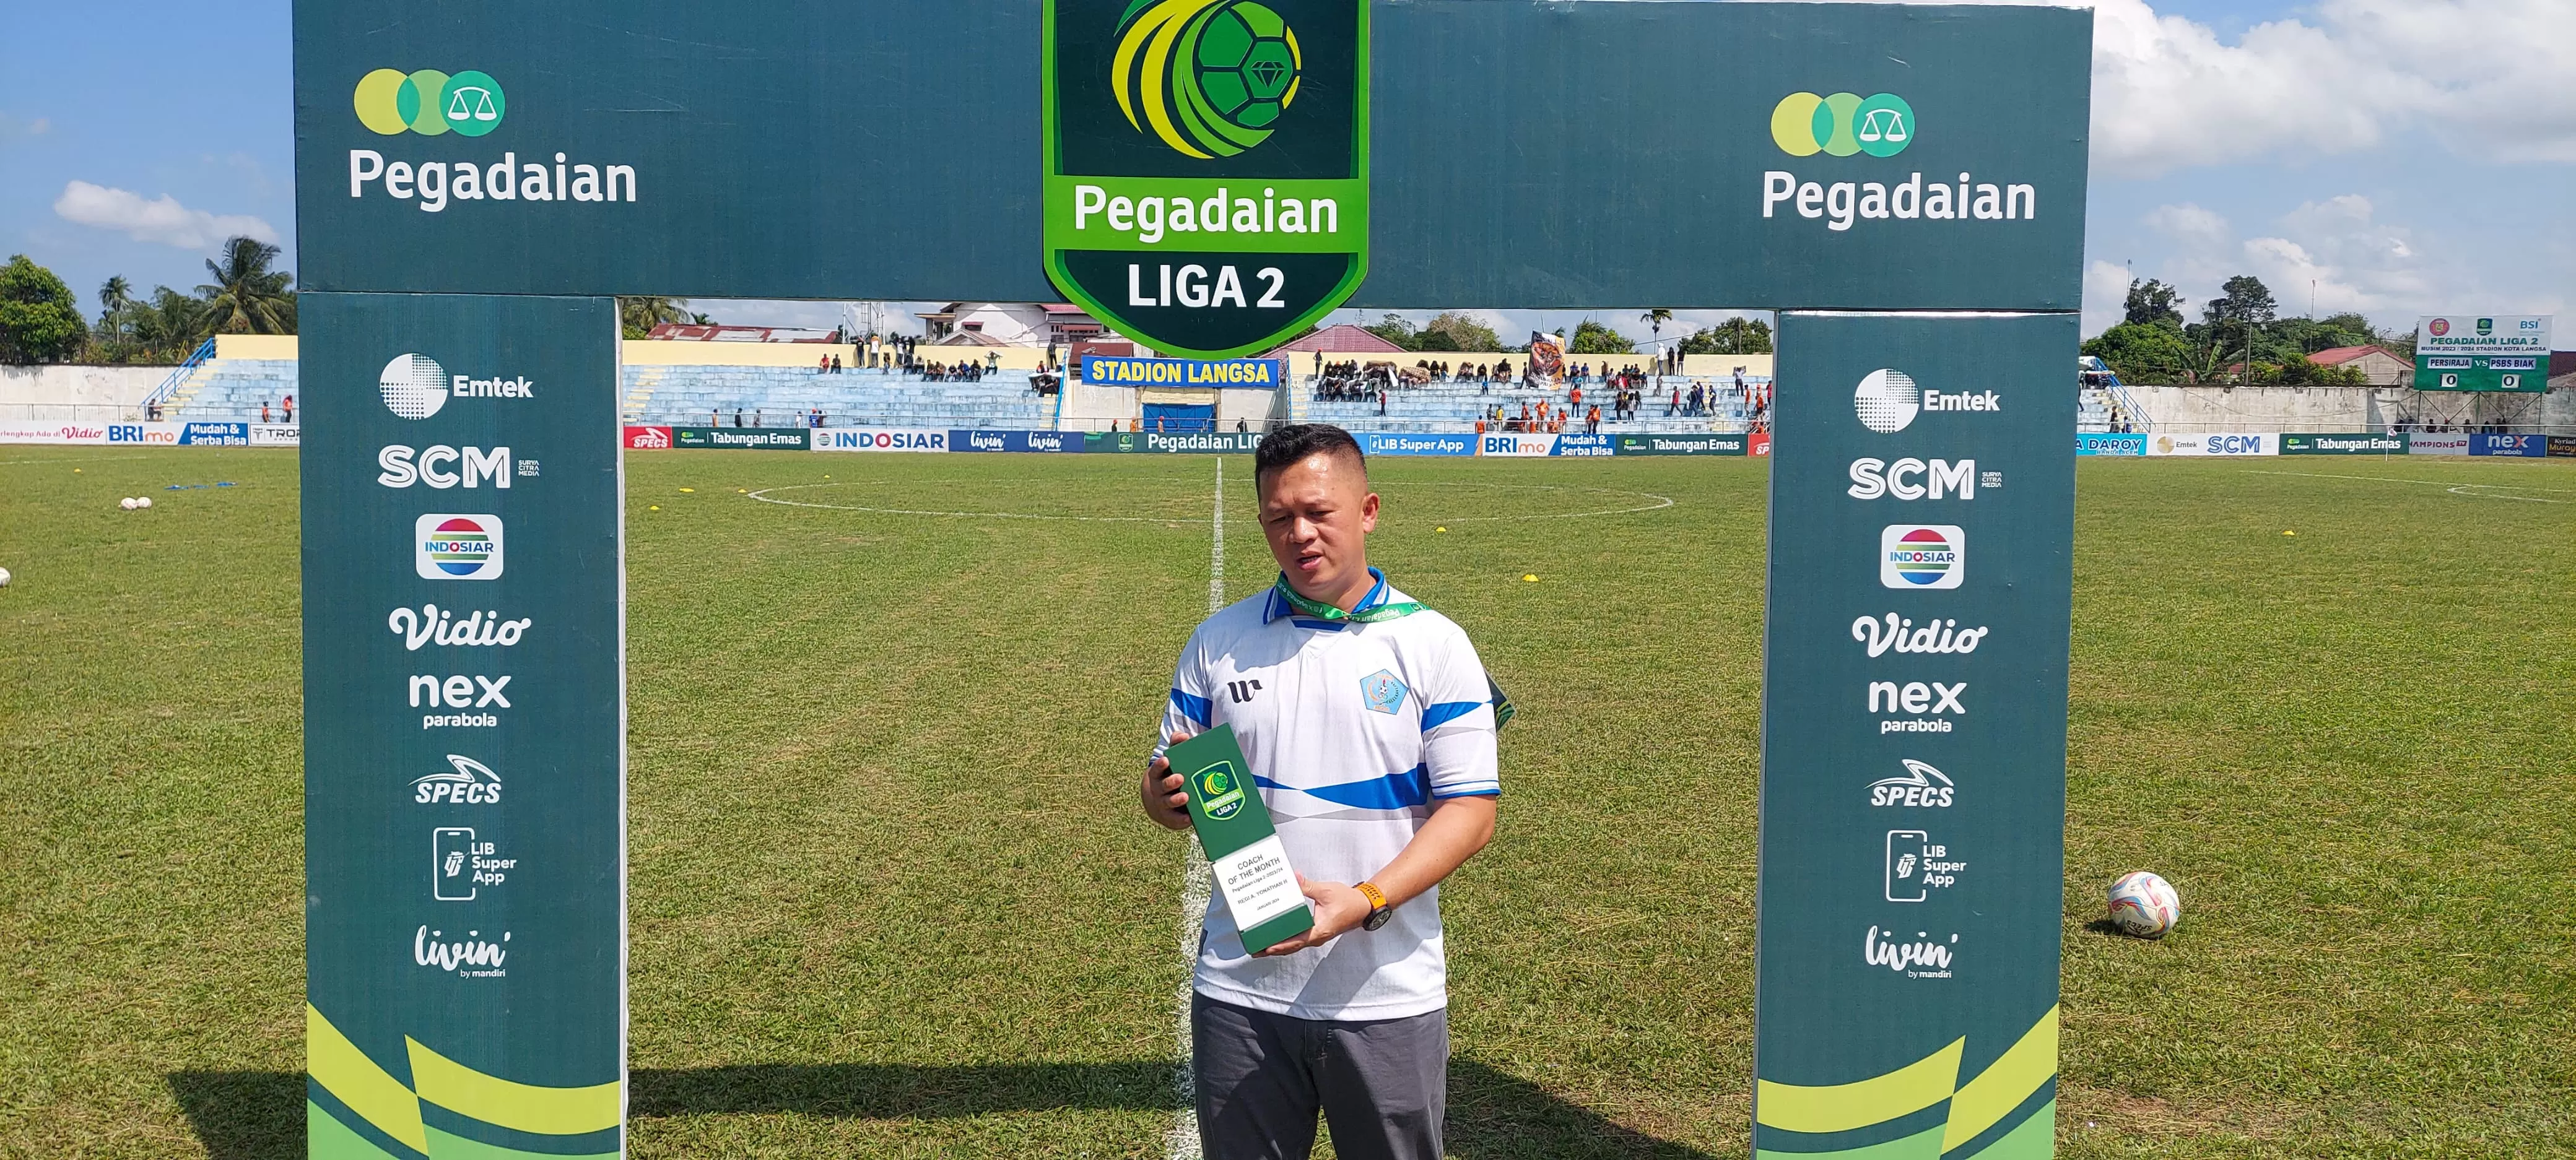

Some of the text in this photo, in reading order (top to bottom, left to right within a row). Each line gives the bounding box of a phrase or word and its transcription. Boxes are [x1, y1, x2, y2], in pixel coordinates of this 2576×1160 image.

[350, 150, 636, 212] Pegadaian
[1763, 171, 2035, 231] Pegadaian
[1074, 184, 1338, 243] Pegadaian
[1128, 264, 1285, 308] LIGA 2
[2520, 321, 2538, 329] BSI
[1092, 360, 1269, 383] STADION LANGSA
[2514, 360, 2535, 368] BIAK
[453, 375, 533, 398] Emtek
[2447, 375, 2456, 384] 0
[2504, 376, 2515, 386] 0
[1924, 390, 2001, 411] Emtek
[61, 426, 103, 439] Vidio
[108, 426, 174, 442] BRImo
[190, 424, 240, 434] Mudah &
[190, 436, 246, 445] Serba Bisa
[633, 438, 668, 448] SPECS
[711, 432, 802, 446] Tabungan Emas
[836, 433, 944, 448] INDOSIAR
[1148, 433, 1264, 452] Pegadaian LIG
[1378, 438, 1464, 452] LIB Super App
[1486, 438, 1546, 452] BRImo
[1561, 435, 1607, 445] Mudah &
[1652, 439, 1739, 452] Tabungan Emas
[2088, 439, 2142, 450] DAROY
[2207, 436, 2260, 453] SCM
[2315, 438, 2401, 451] Tabungan Emas
[2488, 435, 2529, 448] nex
[1560, 447, 1613, 456] Serba Bisa
[377, 445, 510, 489] SCM
[1847, 457, 1975, 500] SCM
[425, 542, 494, 553] INDOSIAR
[1890, 552, 1955, 562] INDOSIAR
[1362, 608, 1400, 621] Pegadaian
[388, 604, 531, 651] Vidio
[1852, 612, 1988, 657] Vidio
[409, 675, 511, 708] nex
[1869, 682, 1967, 714] nex
[424, 712, 497, 730] parabola
[1881, 719, 1952, 734] parabola
[416, 782, 502, 803] SPECS
[1871, 787, 1954, 807] SPECS
[1206, 792, 1239, 809] Pegadaian
[1216, 804, 1232, 816] LIGA
[471, 842, 495, 855] LIB
[1923, 845, 1946, 857] LIB
[472, 856, 517, 872] Super
[1238, 854, 1263, 870] COACH
[1923, 859, 1967, 874] Super
[472, 870, 505, 885] App
[1228, 857, 1280, 885] OF THE MONTH
[1232, 881, 1253, 893] Pegadaian
[1923, 872, 1954, 888] App
[1256, 881, 1283, 896] YONATHAN
[415, 925, 511, 971] livin'
[1866, 925, 1958, 971] livin'
[460, 969, 471, 979] by
[1908, 970, 1952, 979] by mandiri
